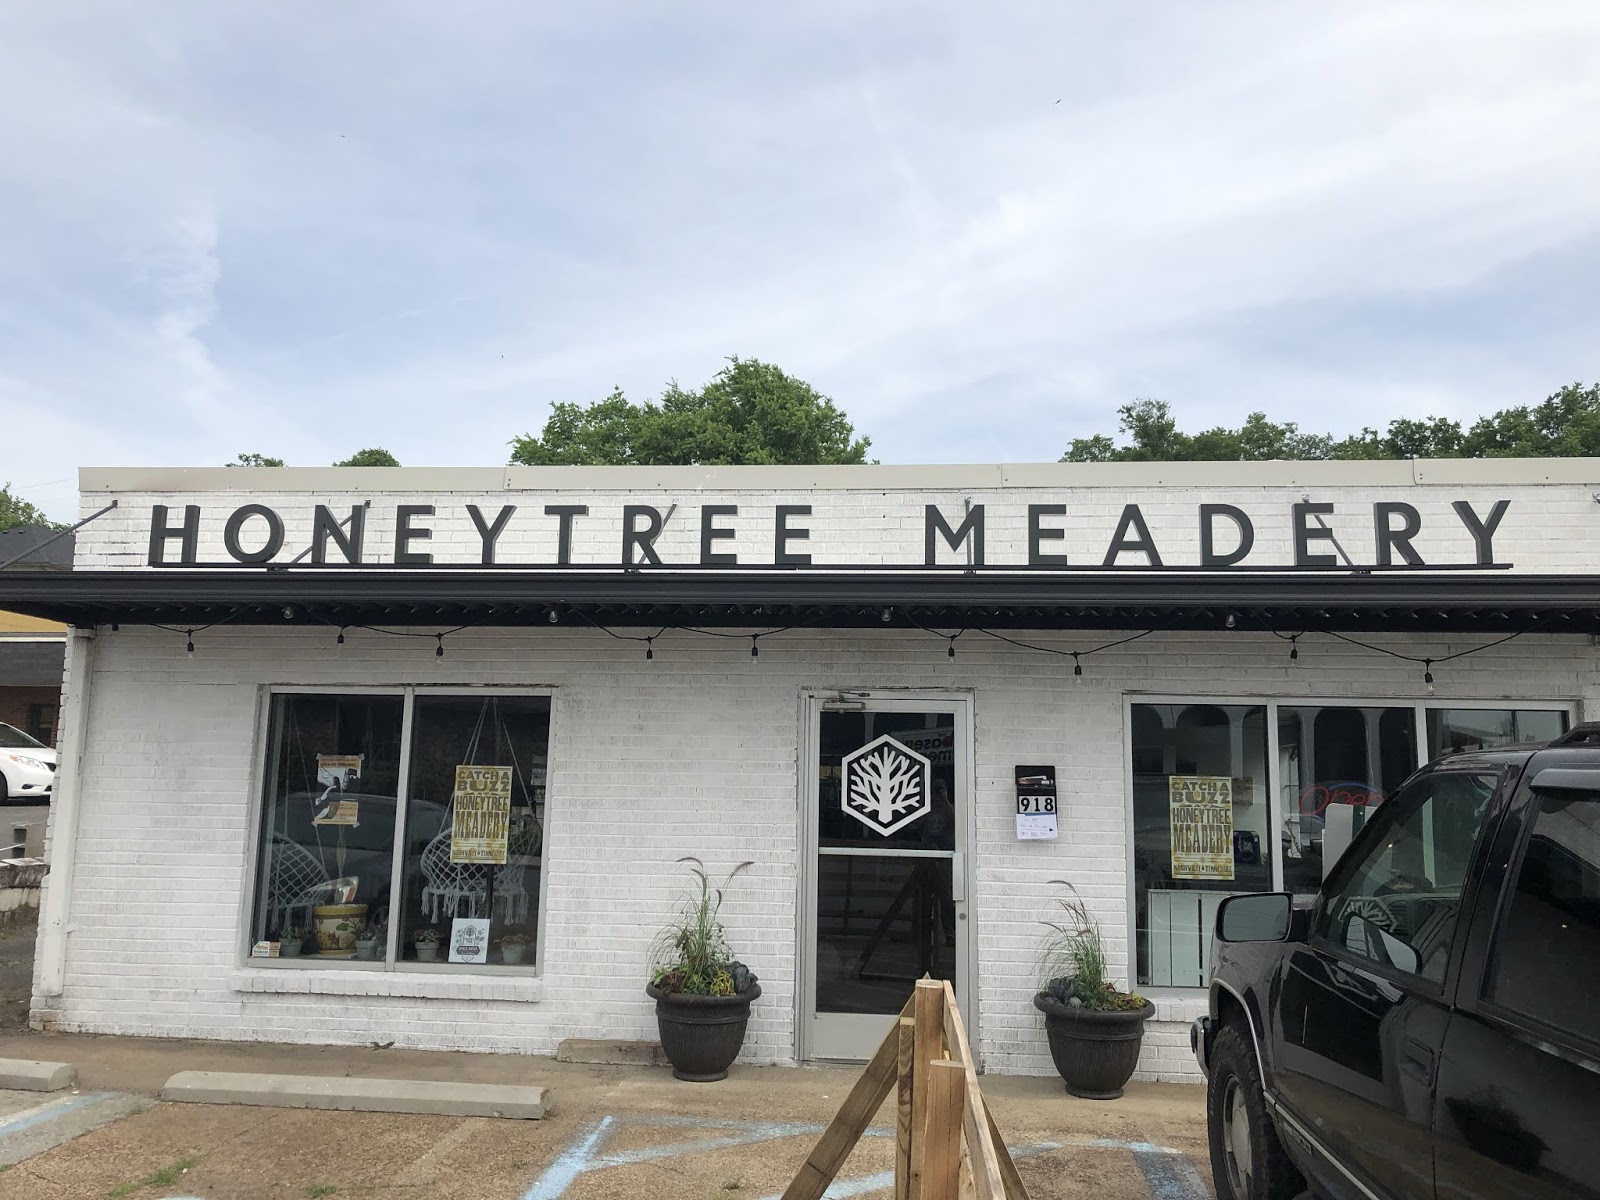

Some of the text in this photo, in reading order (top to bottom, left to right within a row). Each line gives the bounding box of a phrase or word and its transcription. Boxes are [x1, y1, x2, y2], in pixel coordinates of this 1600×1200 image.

[148, 500, 1511, 565] HONEYTREE MEADERY
[457, 771, 499, 780] CATCH
[457, 780, 510, 792] BUZZ
[1171, 781, 1217, 791] CATCH
[455, 796, 509, 811] HONEYTREE
[1020, 797, 1054, 812] 918
[1171, 791, 1231, 804] BUZZ
[1172, 807, 1232, 824] HONEYTREE
[453, 811, 508, 840] MEADERY
[1173, 824, 1231, 853] MEADERY
